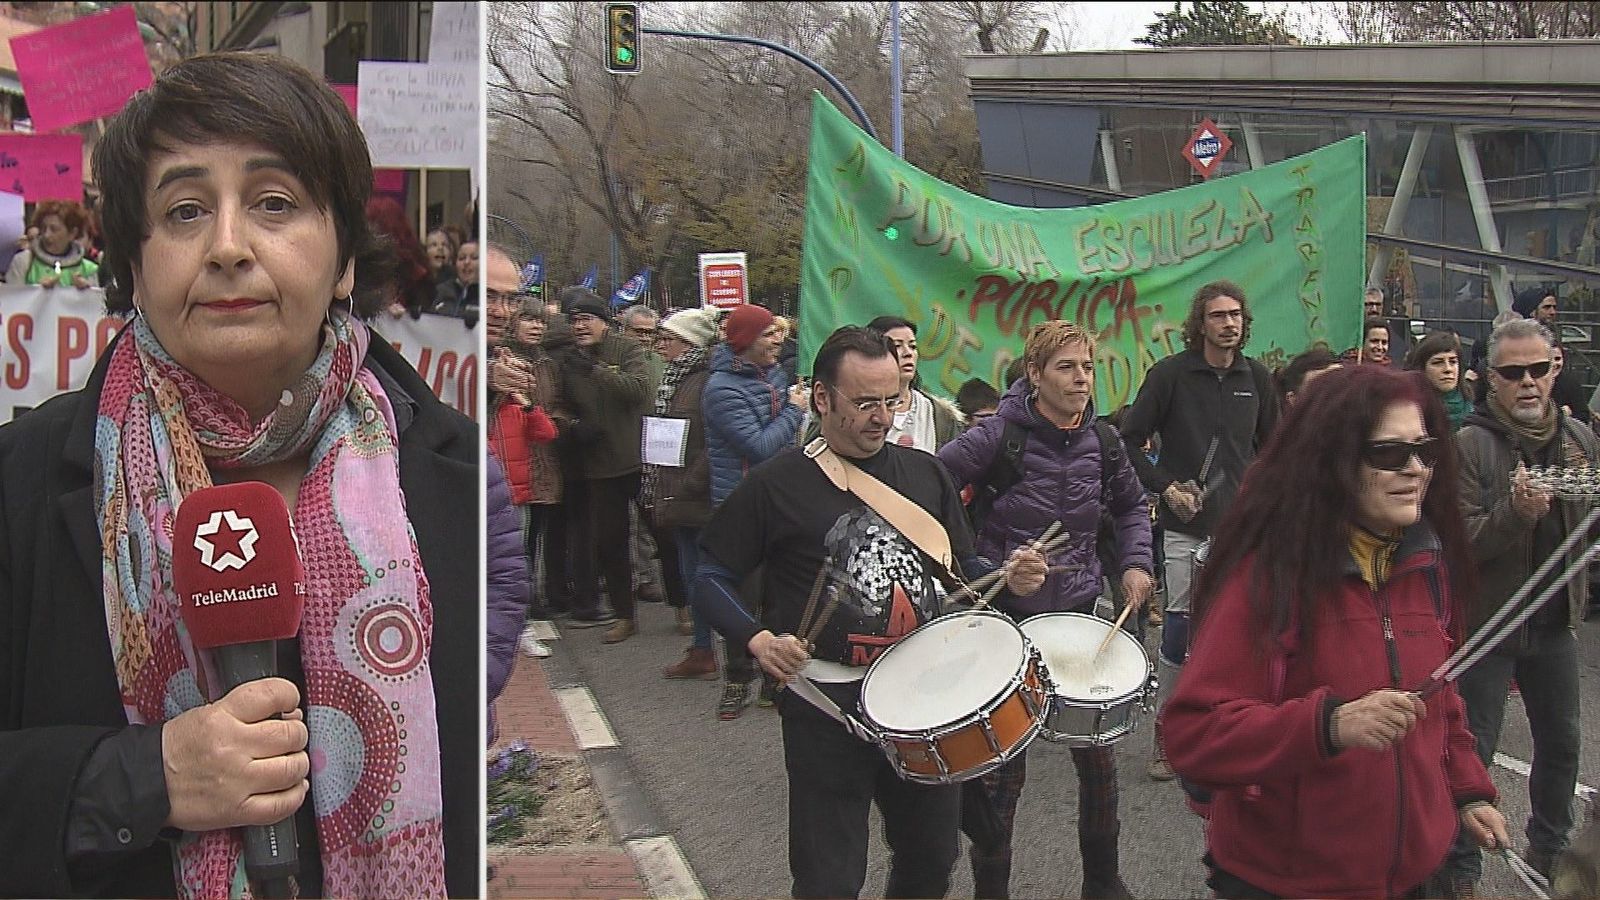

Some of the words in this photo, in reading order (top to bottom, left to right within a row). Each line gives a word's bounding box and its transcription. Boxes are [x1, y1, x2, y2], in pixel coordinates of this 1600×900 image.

[1195, 140, 1218, 156] Metro
[976, 218, 1062, 281] UNA
[1073, 187, 1274, 275] ESCUELA
[192, 583, 278, 607] TeleMadrid
